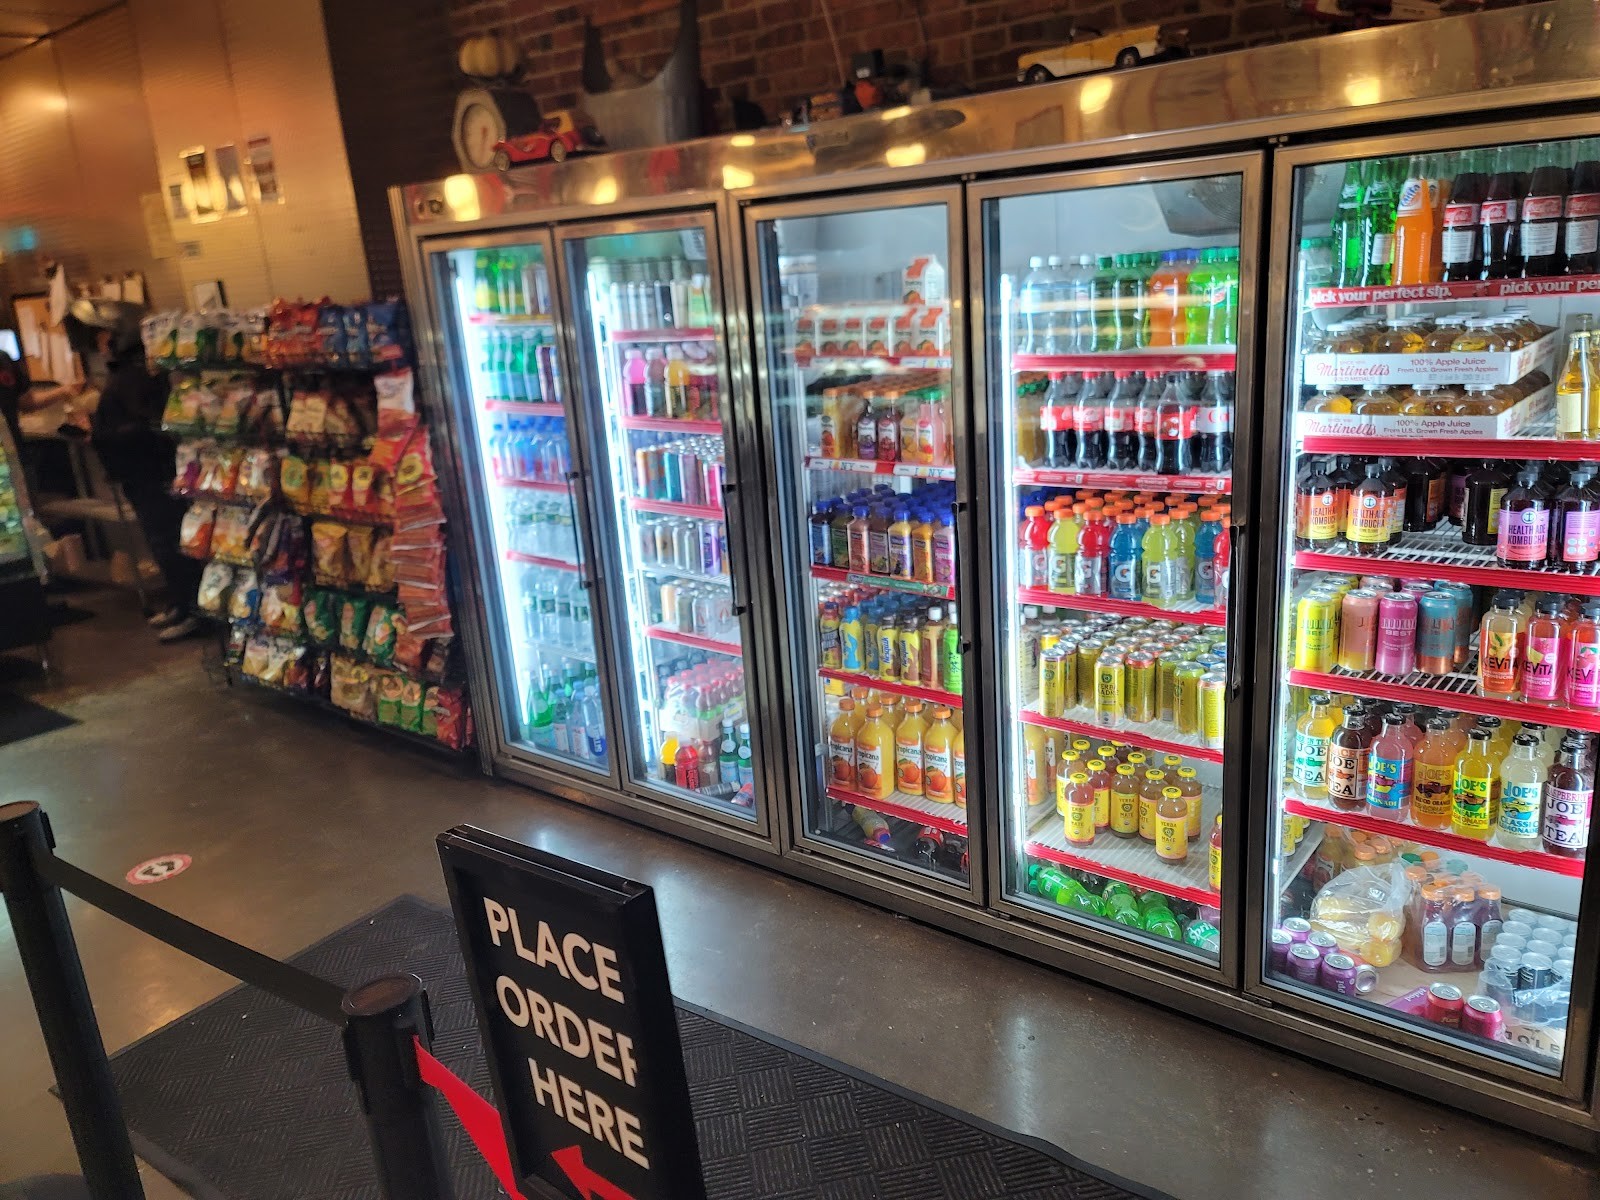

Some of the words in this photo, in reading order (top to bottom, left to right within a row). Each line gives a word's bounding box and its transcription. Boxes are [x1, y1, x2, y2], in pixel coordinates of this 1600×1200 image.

[1338, 289, 1370, 304] your
[1372, 286, 1425, 302] perfect
[1500, 281, 1534, 296] pick
[1536, 280, 1574, 294] your
[1435, 358, 1460, 366] Apple
[1421, 420, 1445, 428] Apple
[1114, 564, 1130, 582] G
[882, 637, 890, 663] Nesquik
[1295, 766, 1325, 782] TEA
[1455, 778, 1487, 792] JOE'S
[1504, 781, 1538, 798] JOE'S
[1547, 799, 1583, 815] JOE
[1500, 814, 1540, 828] CLASSIC
[1545, 824, 1580, 843] TEA
[483, 896, 625, 1004] PLACE
[528, 1057, 650, 1170] HERE
